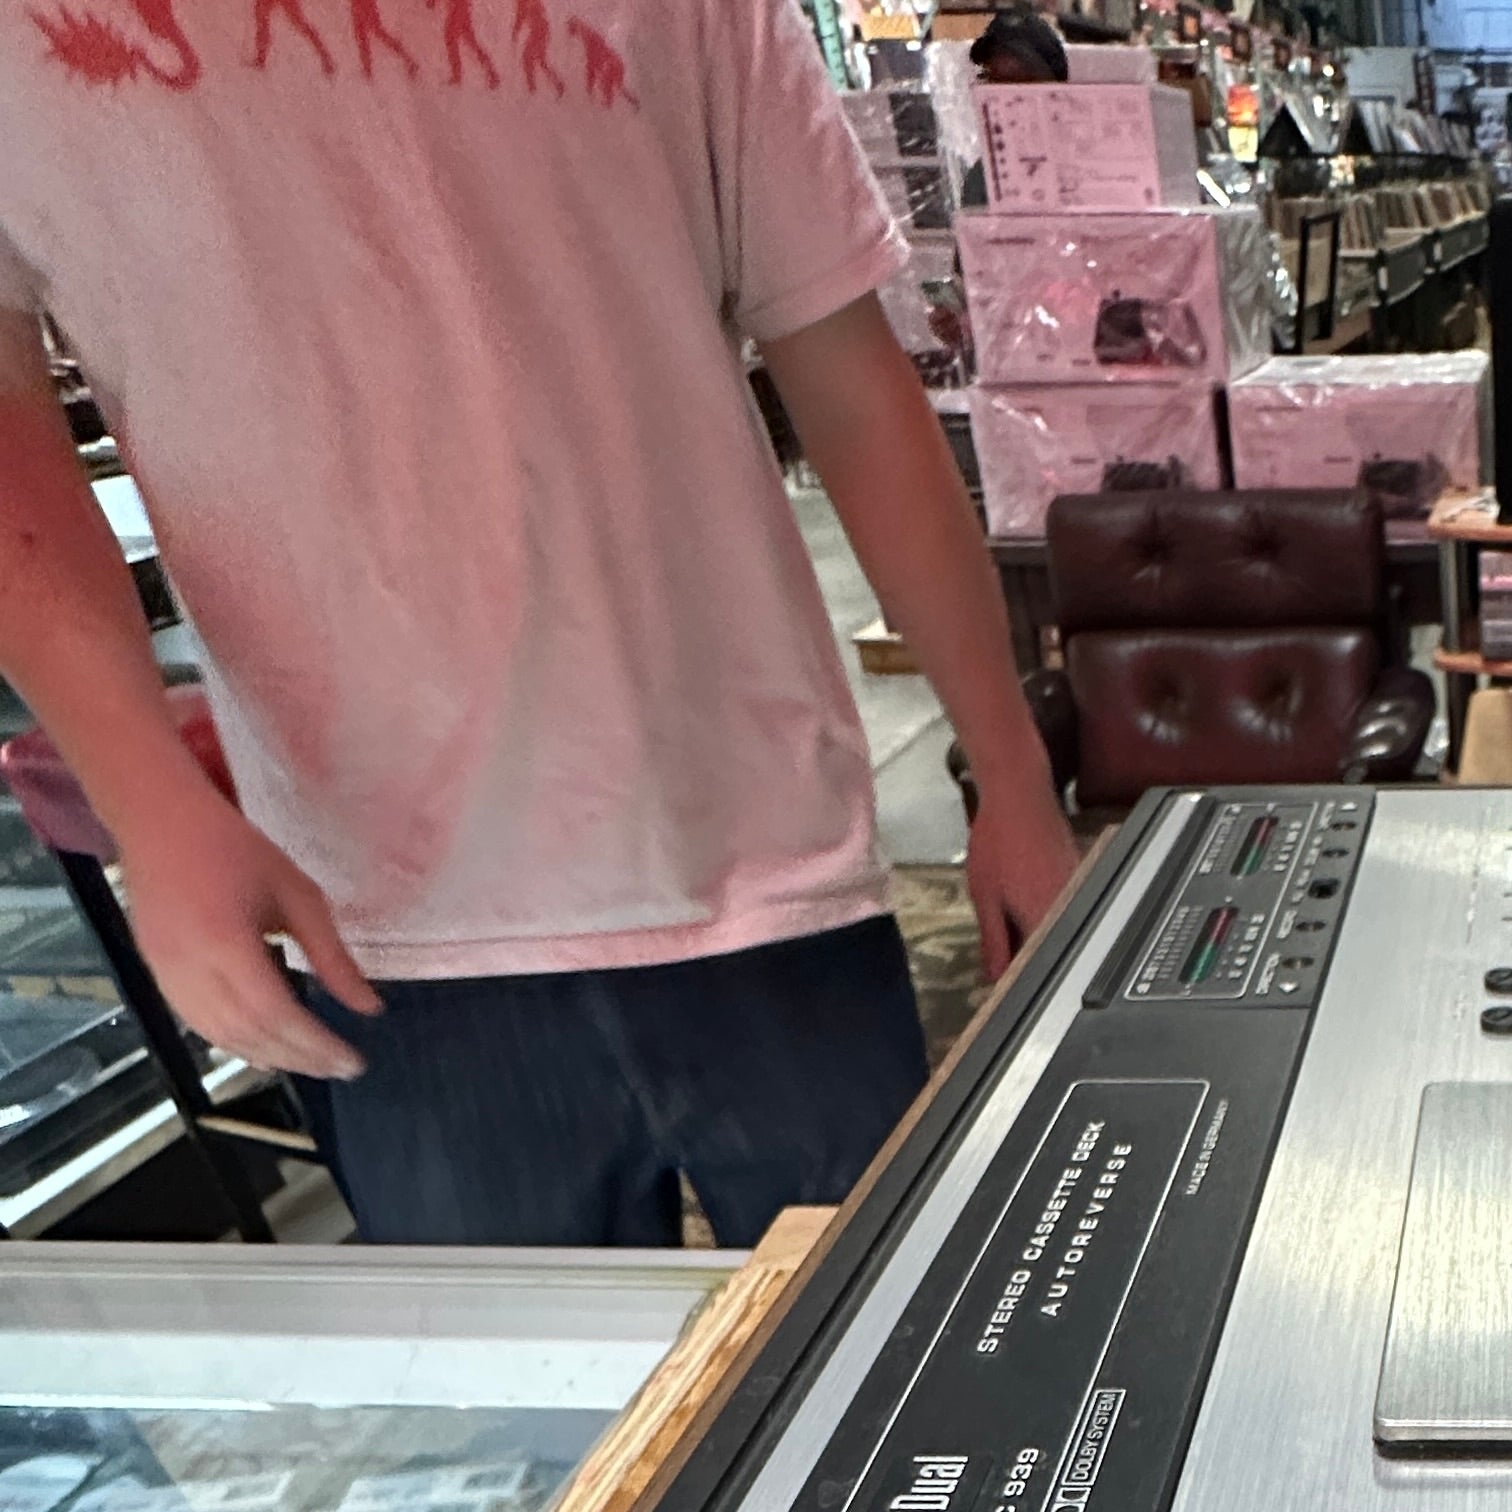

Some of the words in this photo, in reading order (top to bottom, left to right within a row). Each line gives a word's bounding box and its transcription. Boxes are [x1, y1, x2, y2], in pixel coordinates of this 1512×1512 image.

[1185, 1162, 1209, 1196] MADE
[976, 1269, 1032, 1353] STEREO
[1022, 1167, 1083, 1262] CASSETTE
[1071, 1120, 1106, 1162] DECK
[1041, 1143, 1133, 1317] AUTOREVERSE
[1004, 1447, 1040, 1499] 939
[1071, 1439, 1099, 1481] DOLBY
[1087, 1393, 1116, 1440] SYSTEM
[890, 1456, 968, 1512] Dual
